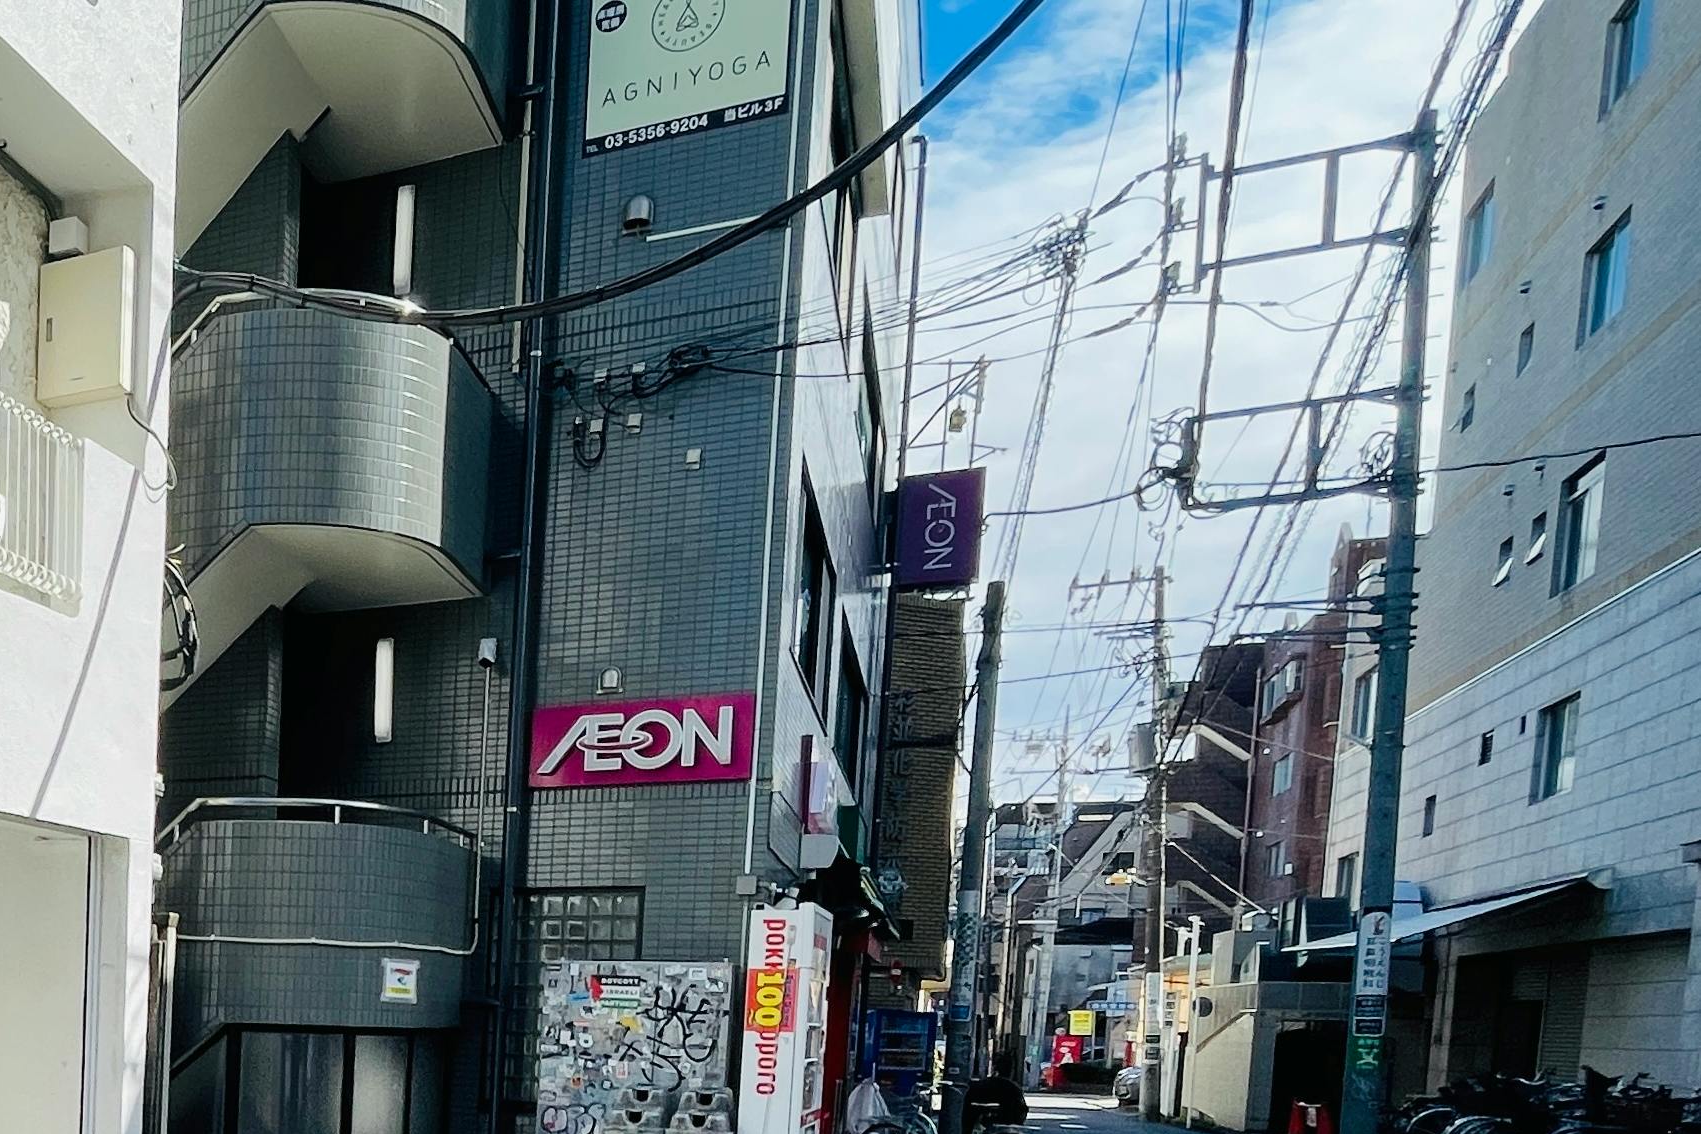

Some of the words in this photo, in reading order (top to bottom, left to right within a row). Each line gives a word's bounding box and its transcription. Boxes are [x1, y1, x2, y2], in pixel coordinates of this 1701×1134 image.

[604, 114, 709, 150] 03-5356-9204
[723, 97, 784, 122] 当ビル3F
